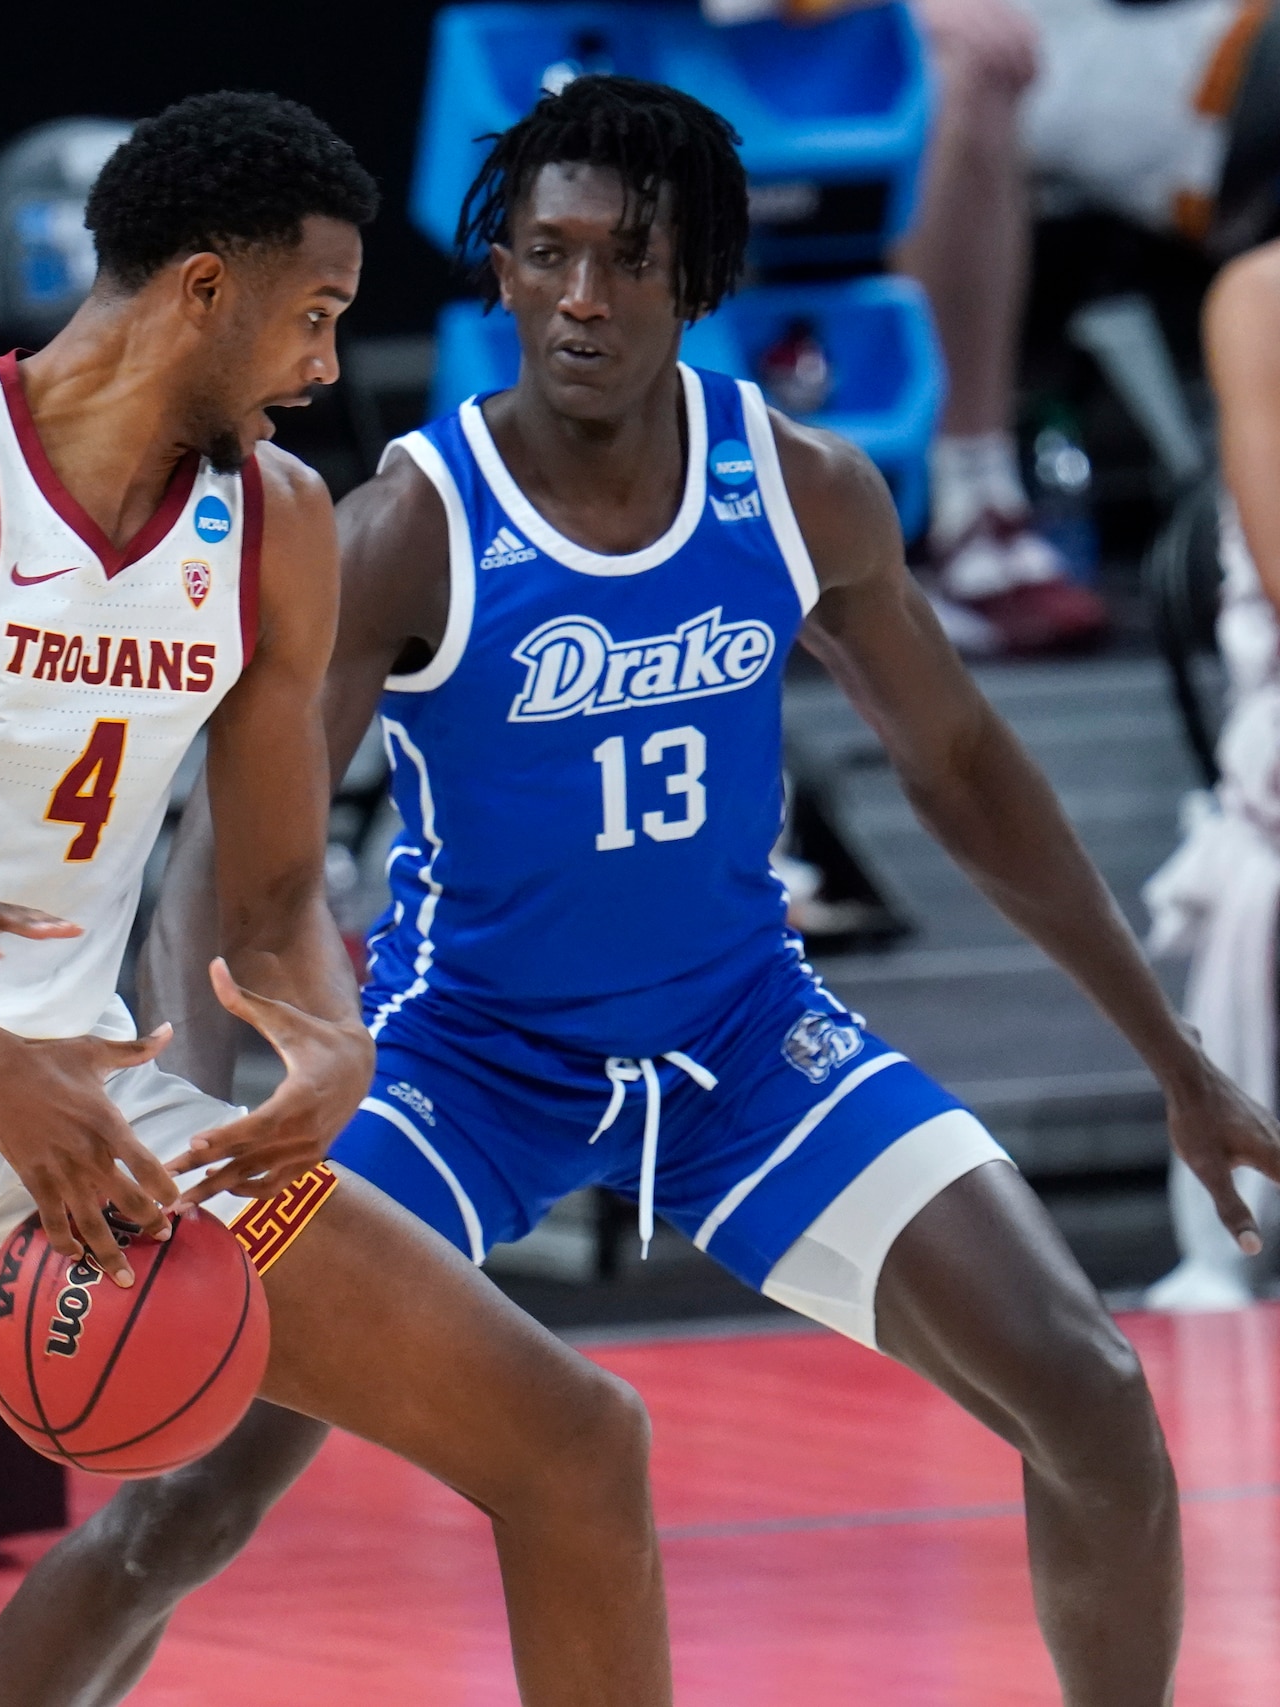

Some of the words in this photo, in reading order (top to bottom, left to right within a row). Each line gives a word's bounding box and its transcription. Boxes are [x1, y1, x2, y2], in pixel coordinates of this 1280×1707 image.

[480, 547, 537, 570] adidas
[5, 622, 216, 693] TROJANS
[507, 605, 776, 723] Drake
[43, 717, 129, 864] 4
[593, 725, 707, 851] 13
